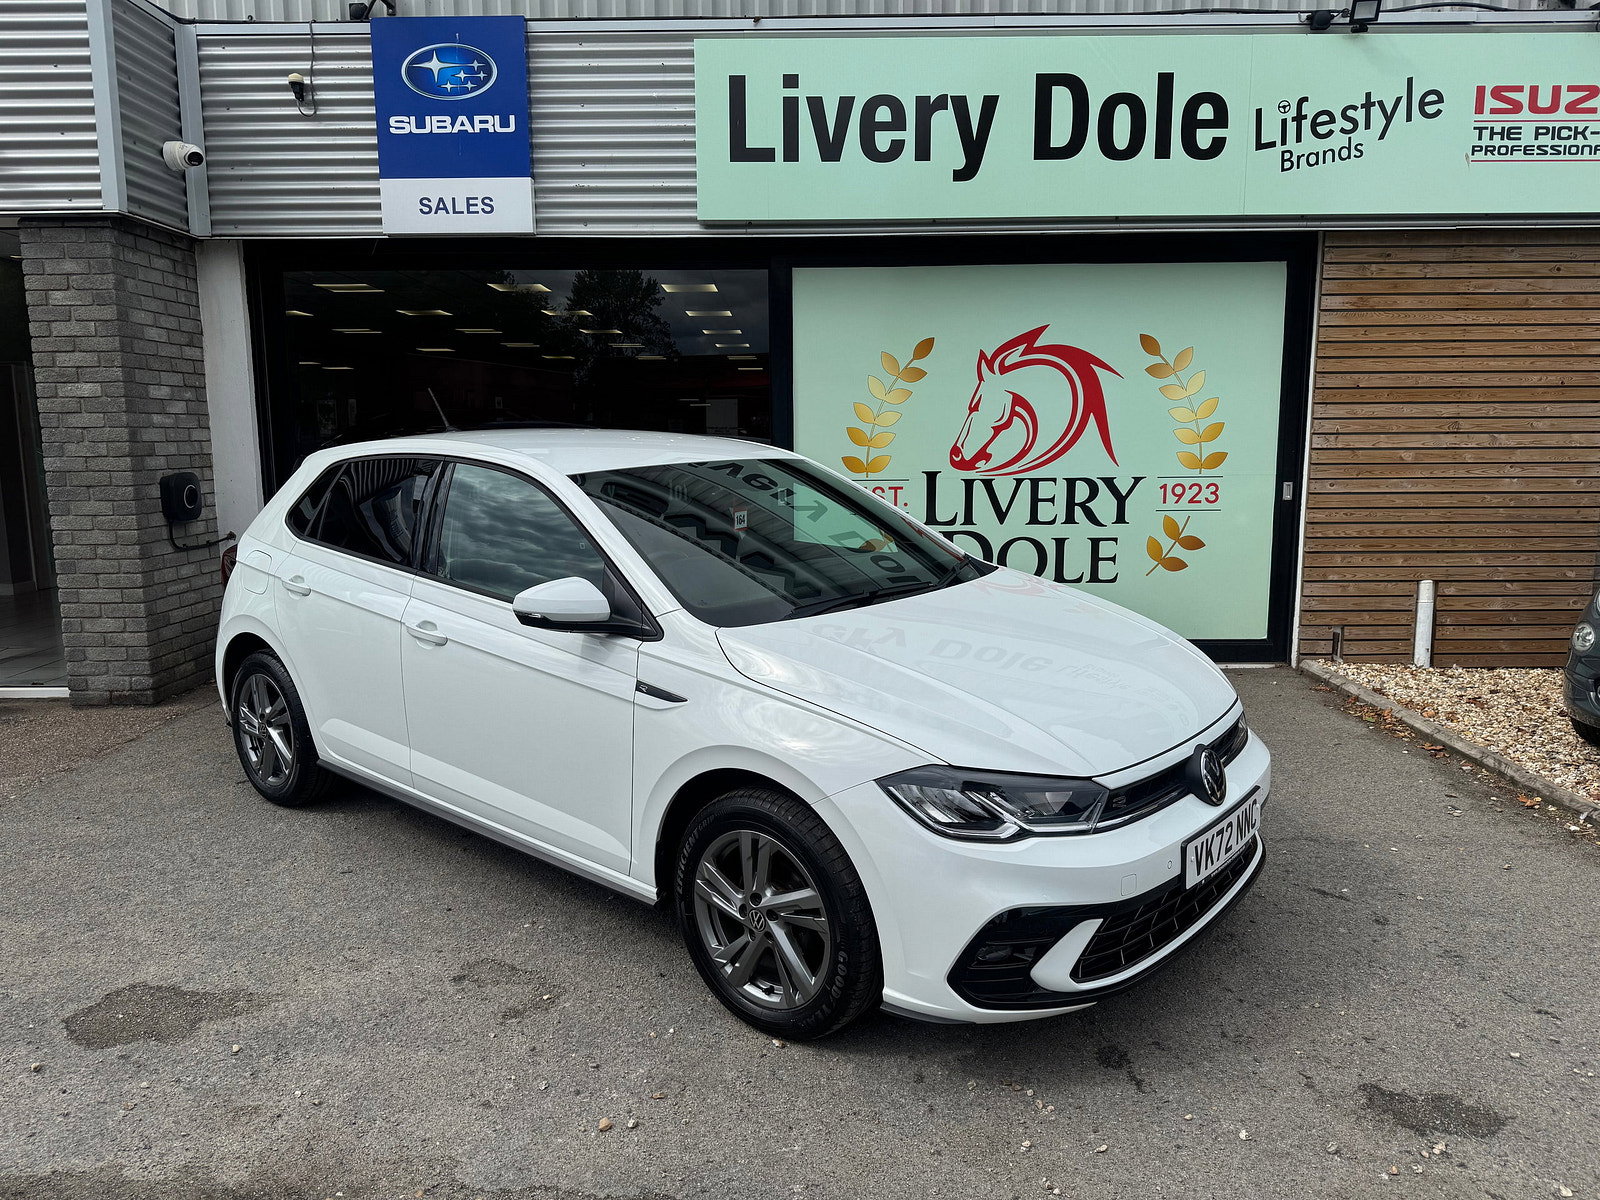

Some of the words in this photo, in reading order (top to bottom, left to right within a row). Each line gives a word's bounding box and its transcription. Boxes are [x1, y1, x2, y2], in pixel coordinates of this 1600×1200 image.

[1255, 76, 1445, 151] Lifestyle
[1474, 84, 1600, 115] ISUZ
[389, 114, 516, 135] SUBARU
[728, 73, 1000, 182] Livery
[1033, 71, 1229, 161] Dole
[1473, 126, 1522, 141] THE
[1280, 136, 1364, 173] Brands
[418, 196, 495, 215] SALES
[864, 485, 909, 507] ST.
[922, 470, 1147, 528] LIVERY
[1159, 482, 1220, 505] 1923
[1194, 821, 1234, 877] VK72
[1235, 798, 1258, 845] NNC
